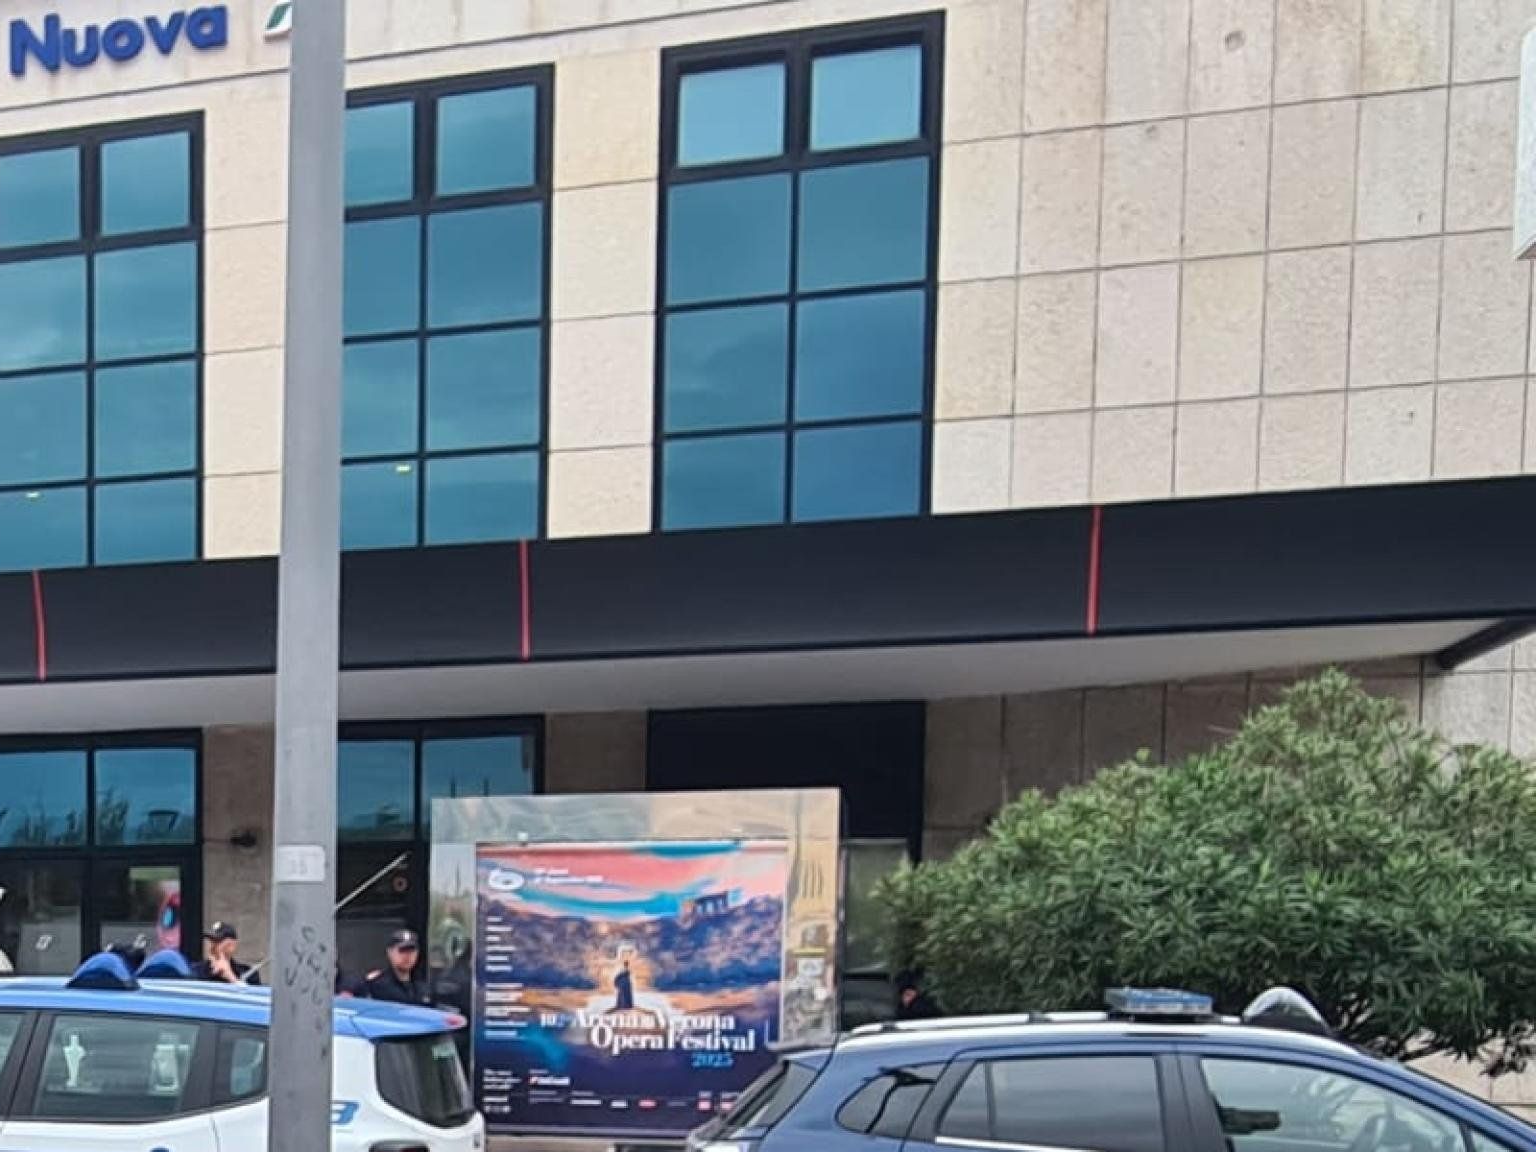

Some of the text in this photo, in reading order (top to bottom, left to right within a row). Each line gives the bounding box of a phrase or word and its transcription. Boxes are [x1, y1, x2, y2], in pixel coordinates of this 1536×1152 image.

[10, 4, 228, 78] Nuova
[590, 1023, 664, 1055] Opera
[667, 1020, 755, 1051] Festival
